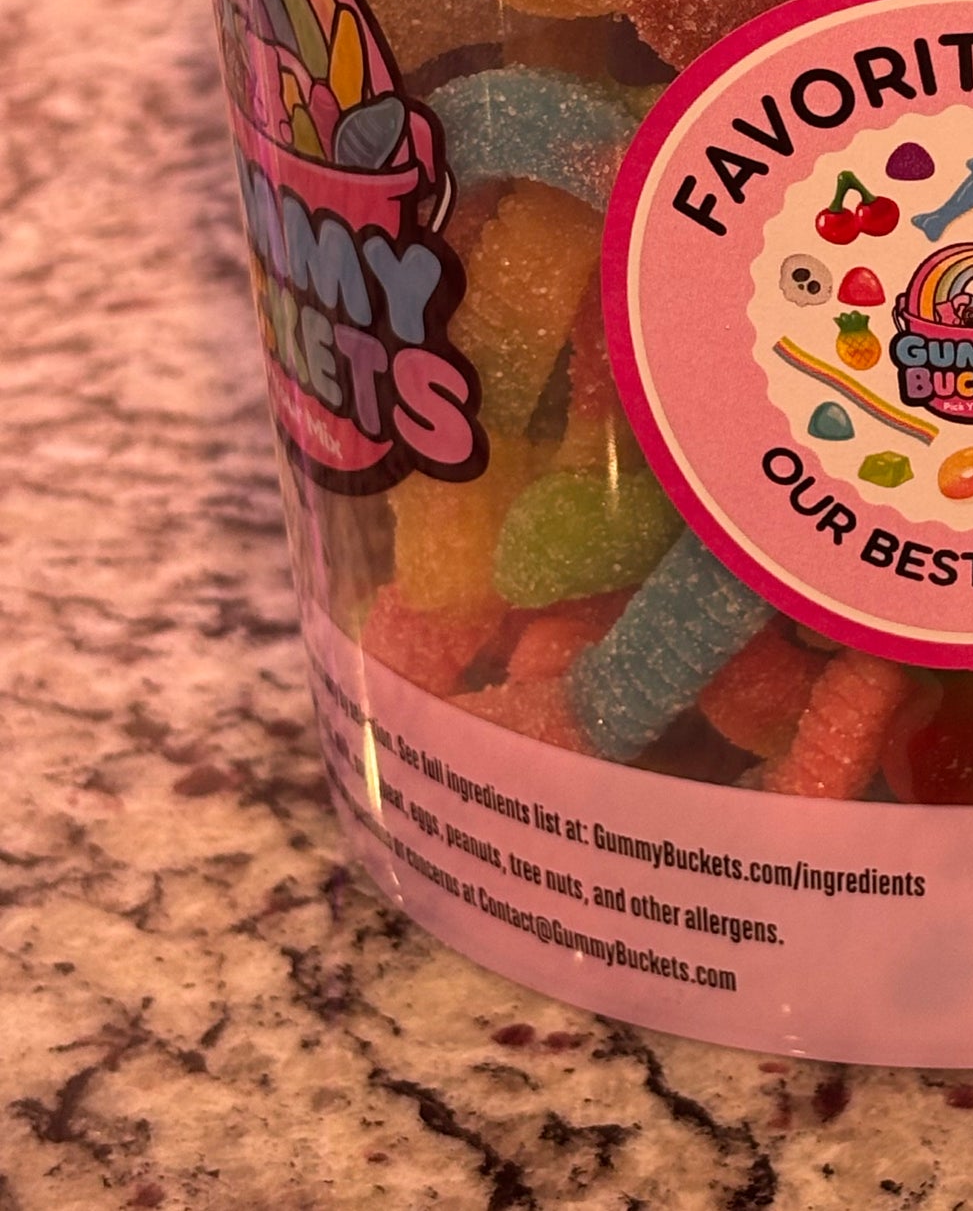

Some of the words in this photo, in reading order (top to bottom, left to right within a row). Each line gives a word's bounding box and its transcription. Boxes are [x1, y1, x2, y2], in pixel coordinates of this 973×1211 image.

[943, 400, 965, 412] Pick
[761, 446, 858, 547] OUR
[397, 734, 420, 770] See
[421, 750, 445, 786] full
[445, 769, 531, 824] ingredients
[534, 804, 562, 834] list
[563, 820, 590, 846] at:
[593, 823, 927, 897] GummyBuckets.com/ingredients
[411, 803, 444, 842] eggs,
[446, 821, 508, 875] peanuts,
[509, 852, 542, 888] tree
[545, 869, 590, 908] nuts,
[593, 881, 627, 914] and
[631, 890, 680, 928] other
[684, 899, 785, 946] allergens.
[406, 846, 461, 898] concerns
[462, 878, 478, 904] at
[478, 884, 737, 992] Contact@GummyBuckets.com
